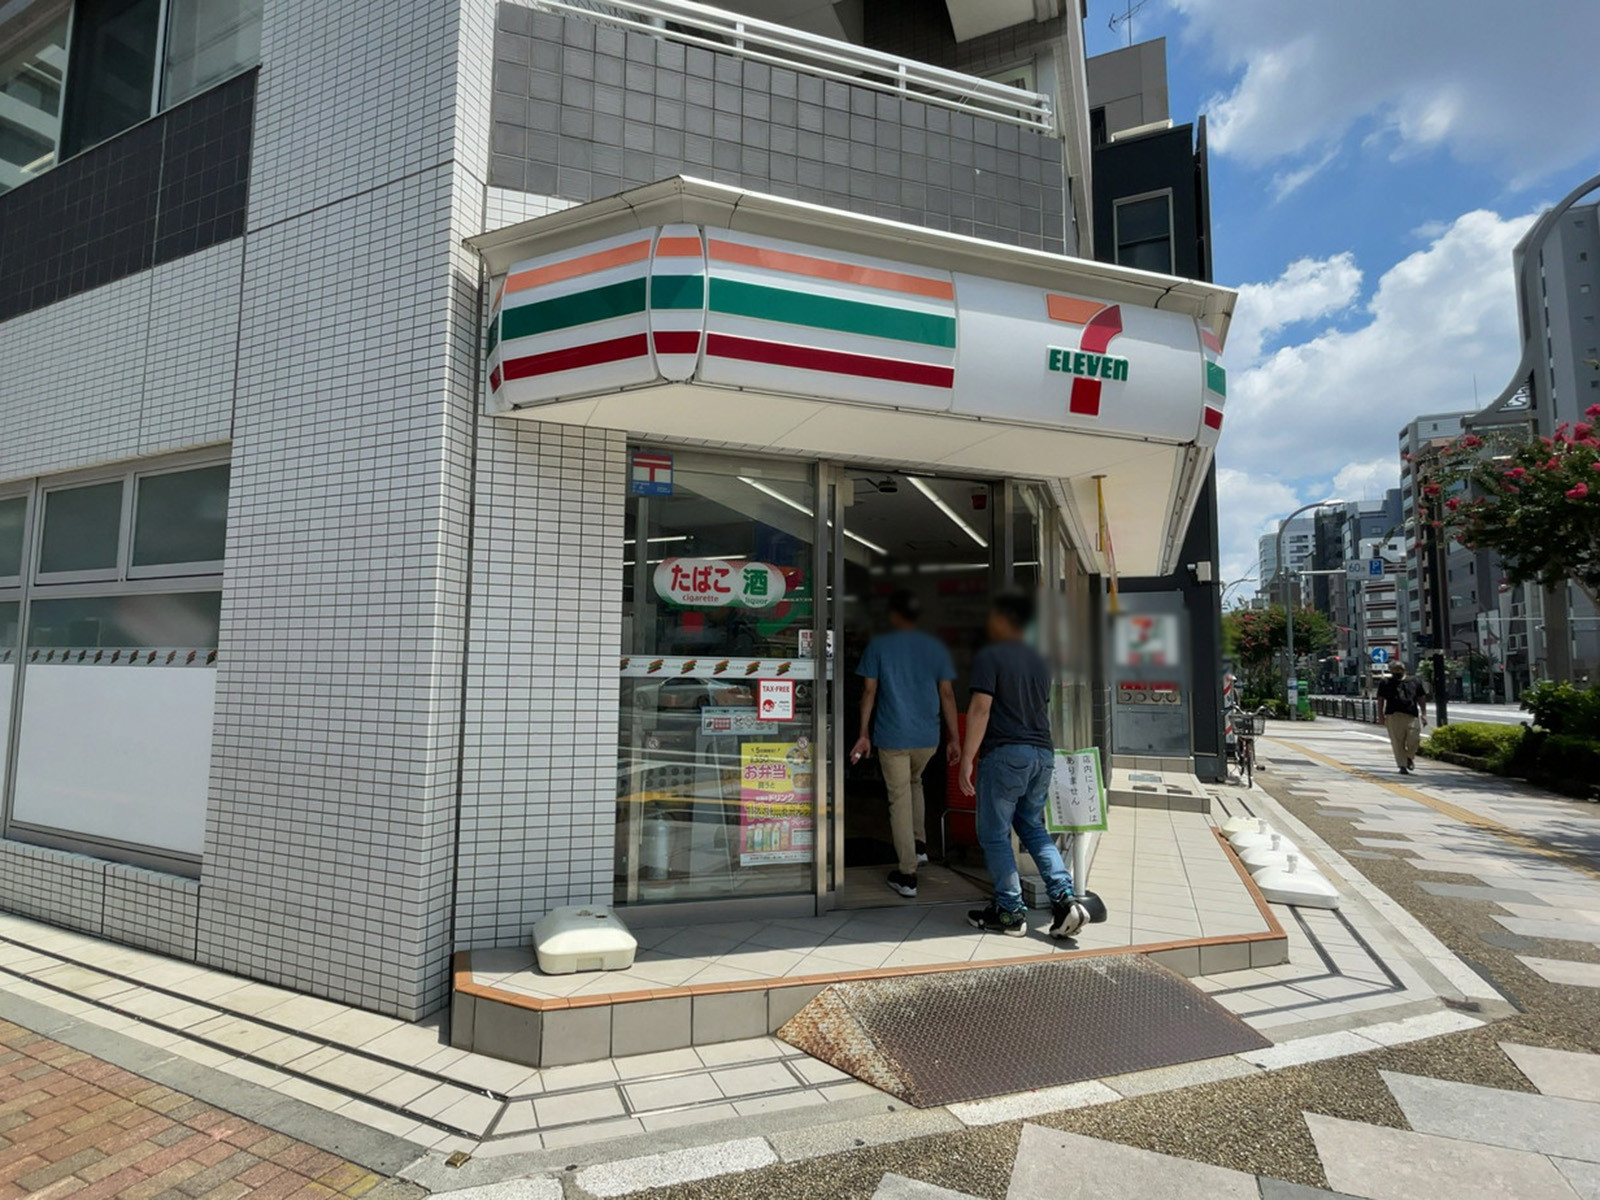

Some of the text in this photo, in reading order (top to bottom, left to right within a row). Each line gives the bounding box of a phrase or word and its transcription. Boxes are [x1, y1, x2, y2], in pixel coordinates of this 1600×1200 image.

[671, 564, 768, 596] たばこ 酒
[682, 594, 719, 603] cigarette
[745, 596, 768, 605] liquor
[1066, 756, 1081, 806] ありません
[1082, 755, 1097, 822] 店内にトイレは
